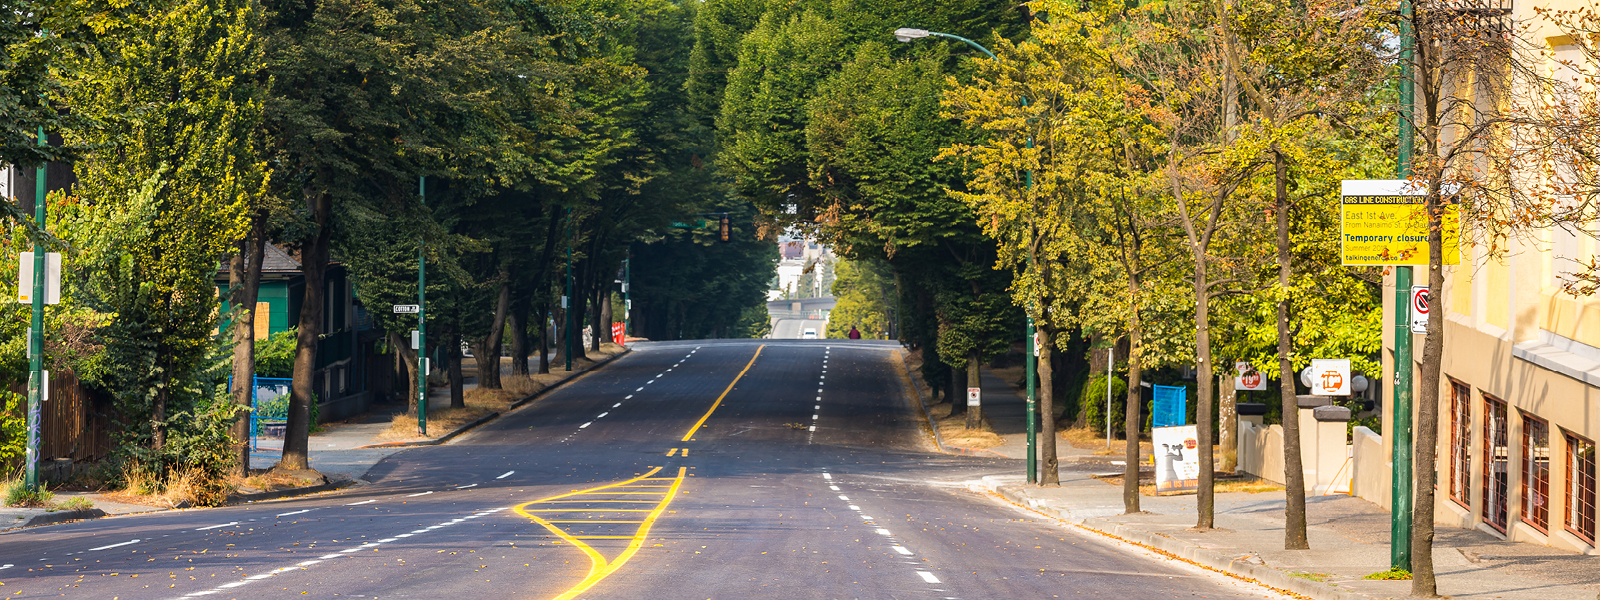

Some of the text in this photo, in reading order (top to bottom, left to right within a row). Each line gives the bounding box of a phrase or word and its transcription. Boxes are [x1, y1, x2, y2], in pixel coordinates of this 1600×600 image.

[1344, 196, 1358, 204] GAS
[1359, 196, 1375, 204] LINE
[1345, 211, 1397, 220] East 1st Ave.
[1344, 233, 1393, 243] Temporary
[1345, 244, 1371, 252] Summer
[1173, 480, 1182, 489] US
